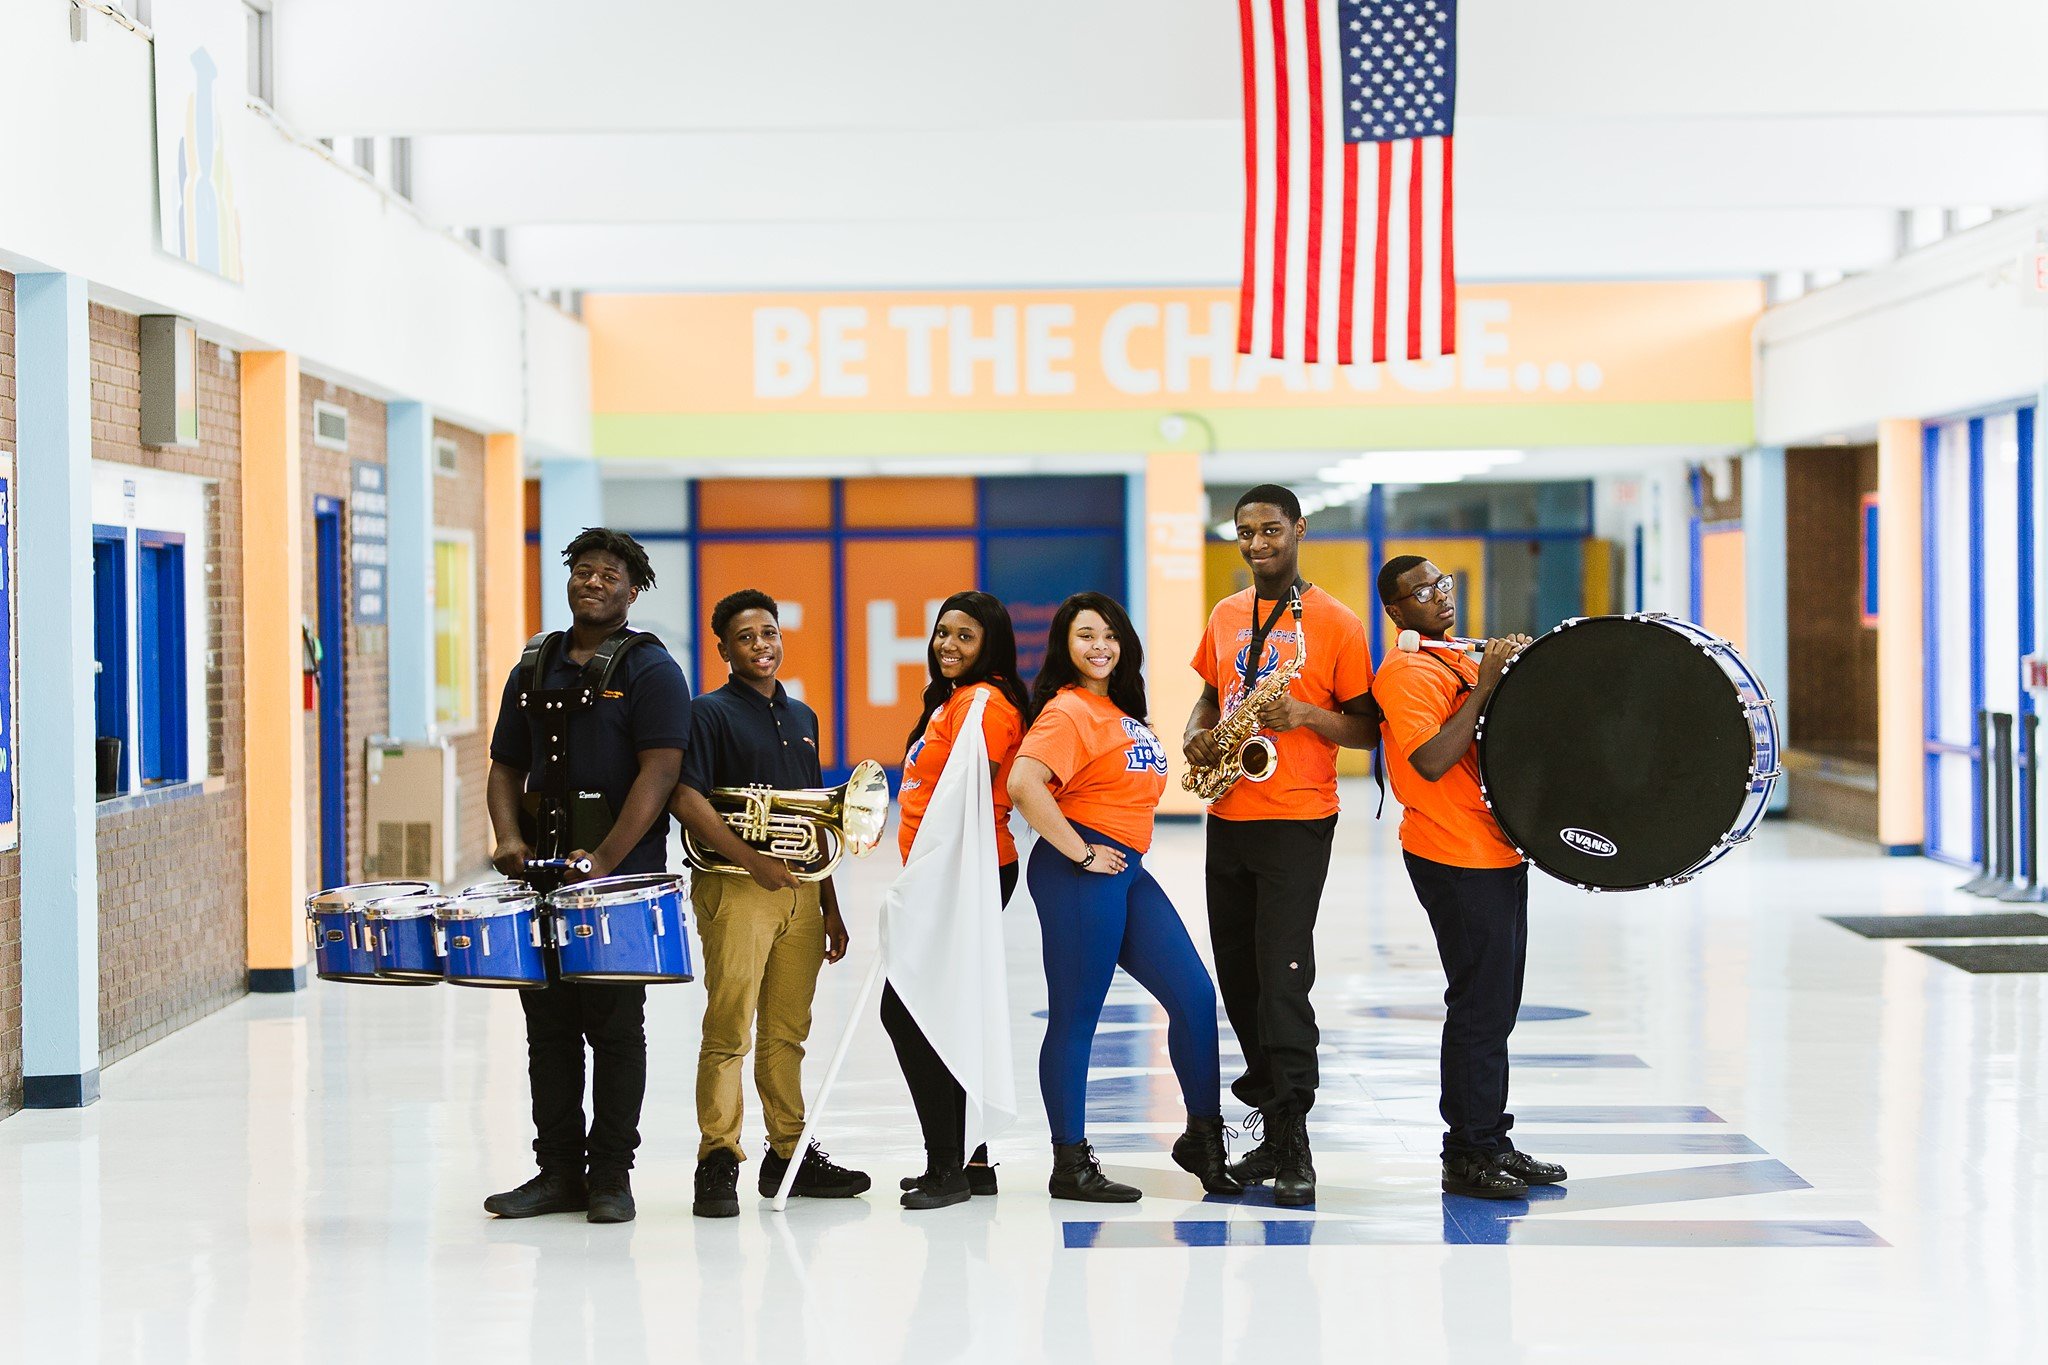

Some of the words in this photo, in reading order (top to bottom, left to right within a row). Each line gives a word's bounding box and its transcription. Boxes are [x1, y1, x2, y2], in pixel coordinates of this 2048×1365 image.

[753, 306, 869, 398] BE
[888, 304, 1076, 397] THE
[1566, 831, 1610, 853] EVANS
